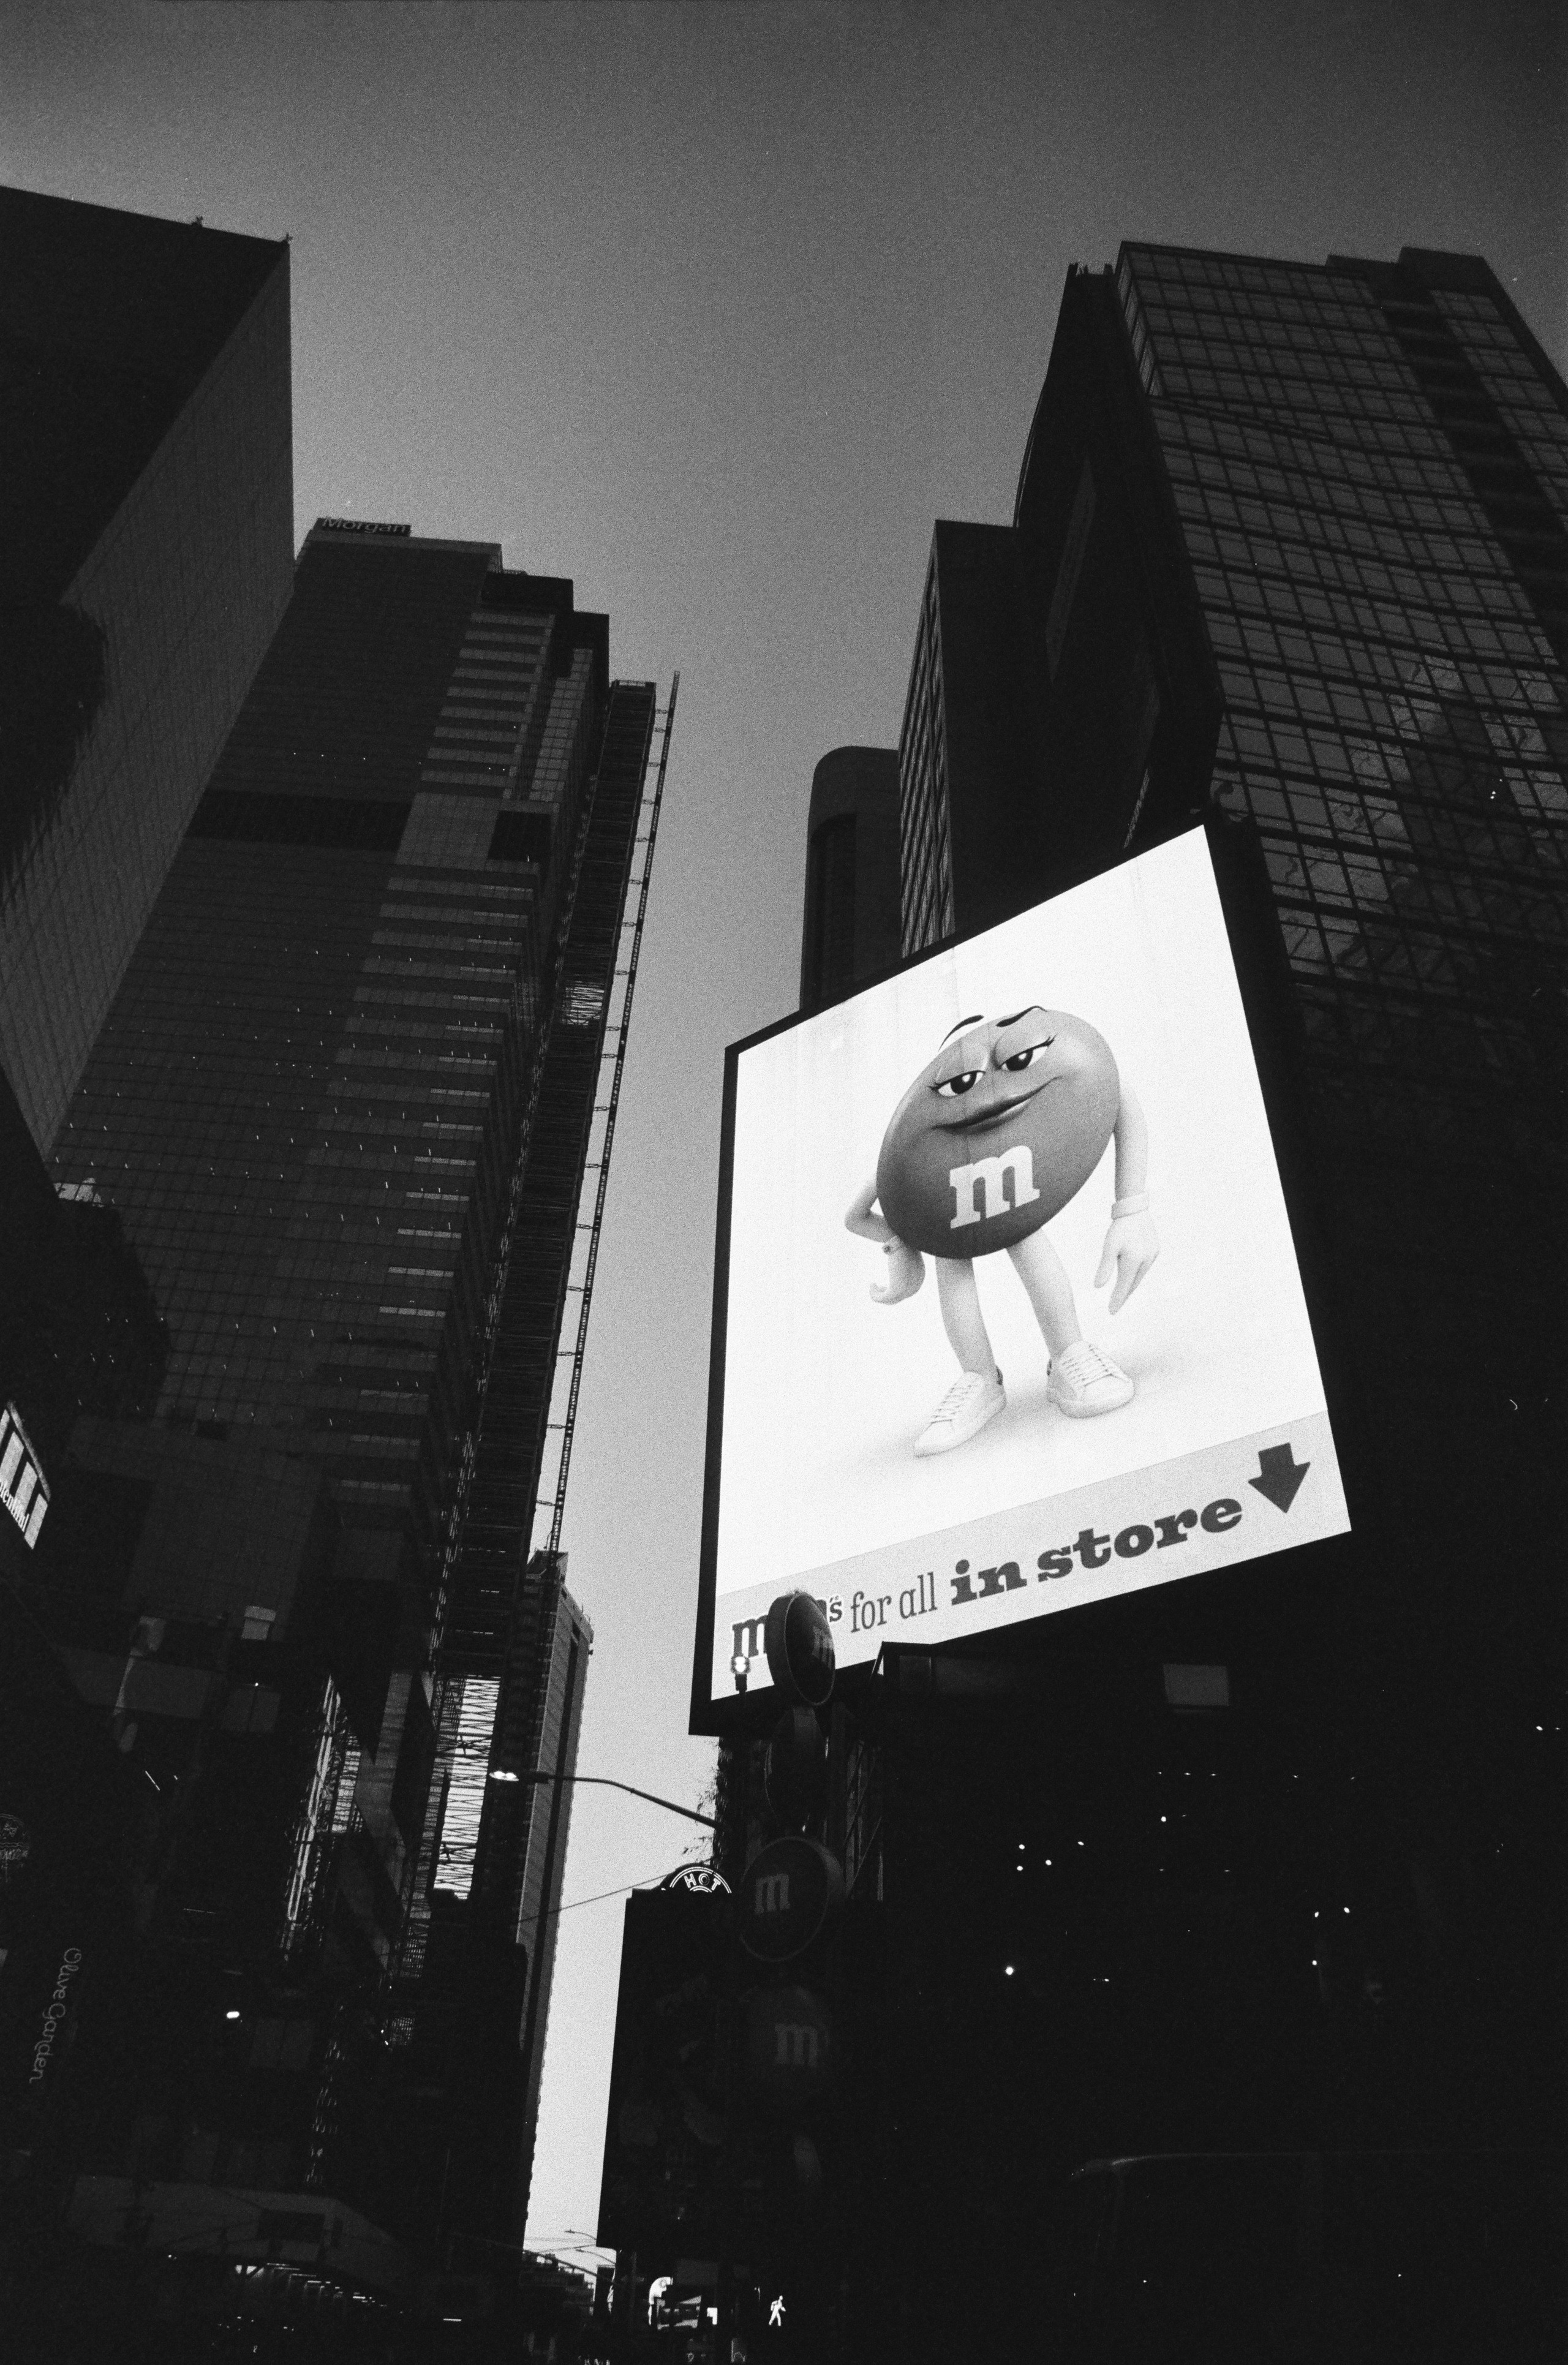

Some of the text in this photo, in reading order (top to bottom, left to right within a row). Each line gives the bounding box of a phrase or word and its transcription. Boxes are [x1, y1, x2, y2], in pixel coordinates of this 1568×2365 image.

[322, 516, 406, 534] Morgan
[949, 1145, 1040, 1229] m
[850, 1591, 892, 1633] for
[899, 1571, 938, 1620] all
[951, 1559, 1028, 1606] in
[1037, 1498, 1243, 1583] store
[684, 1873, 722, 1892] HOT
[755, 1873, 791, 1916] m
[29, 1947, 82, 2084] Olive Garden
[774, 2023, 820, 2068] m
